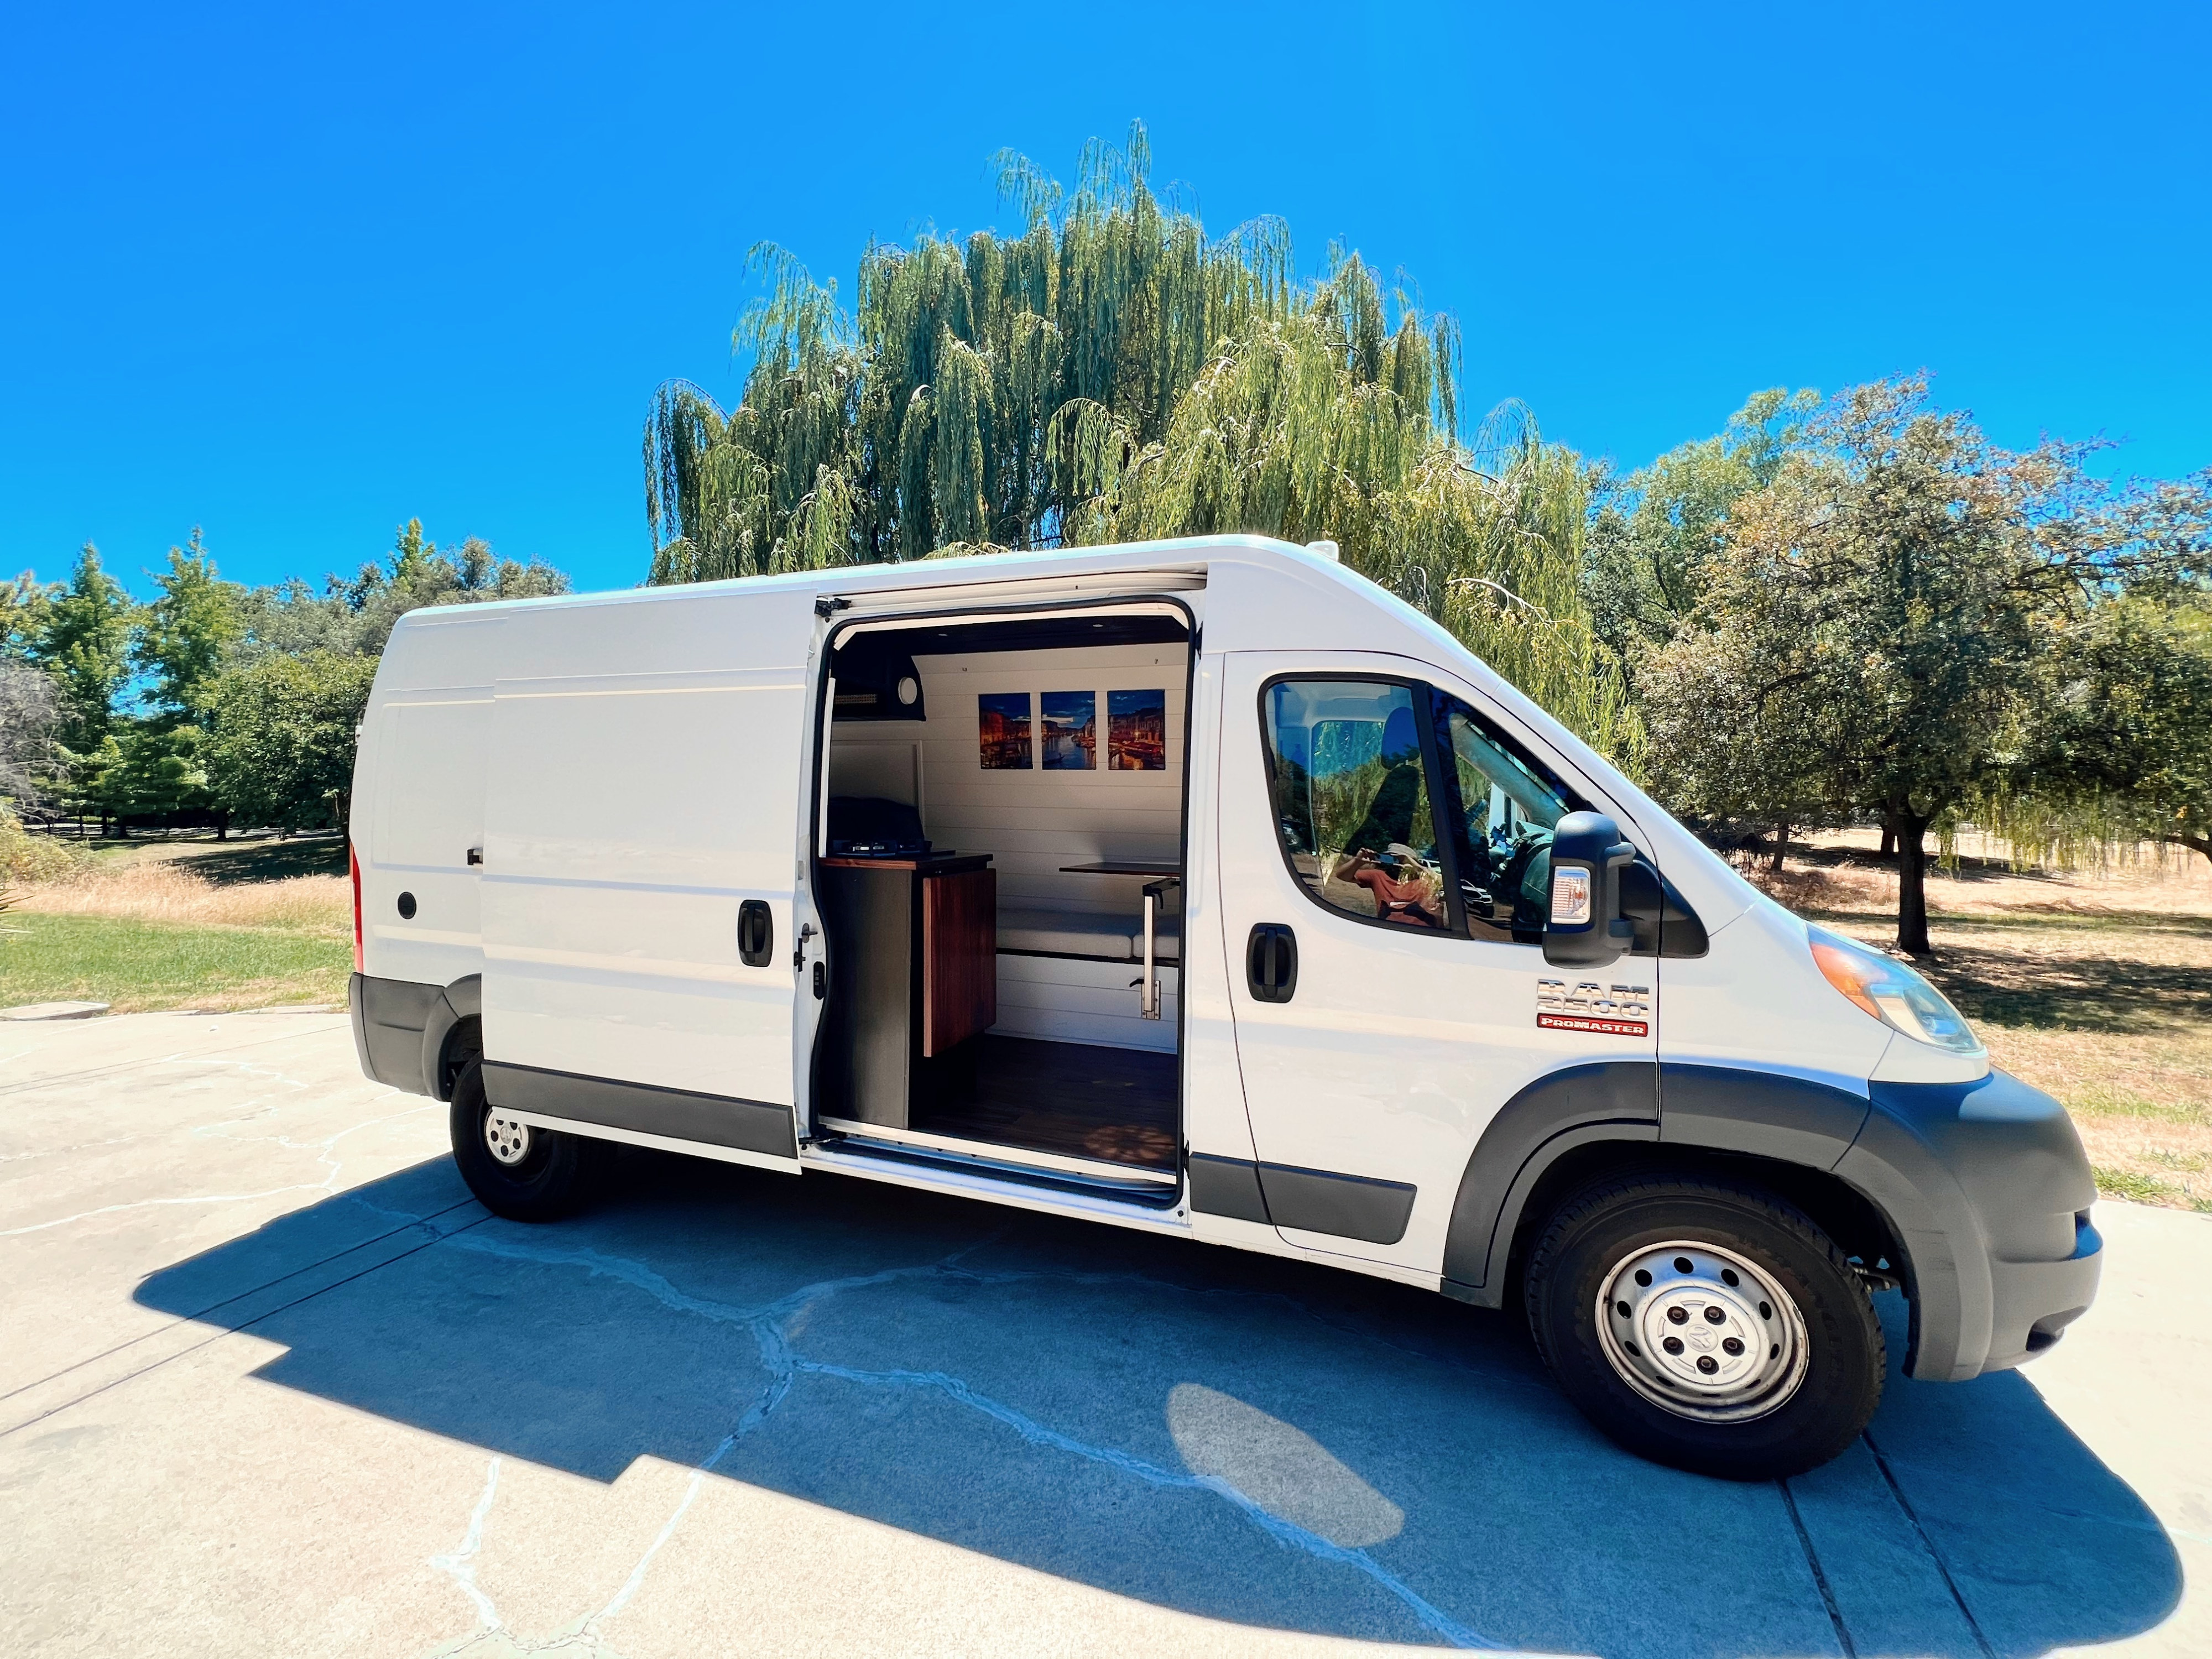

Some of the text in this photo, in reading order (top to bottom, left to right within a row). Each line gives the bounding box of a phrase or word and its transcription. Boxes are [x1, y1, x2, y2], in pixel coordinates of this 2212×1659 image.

[1537, 979, 1649, 1001] RAM
[1537, 995, 1649, 1019] 2500
[1541, 1017, 1644, 1034] PROMASTER
